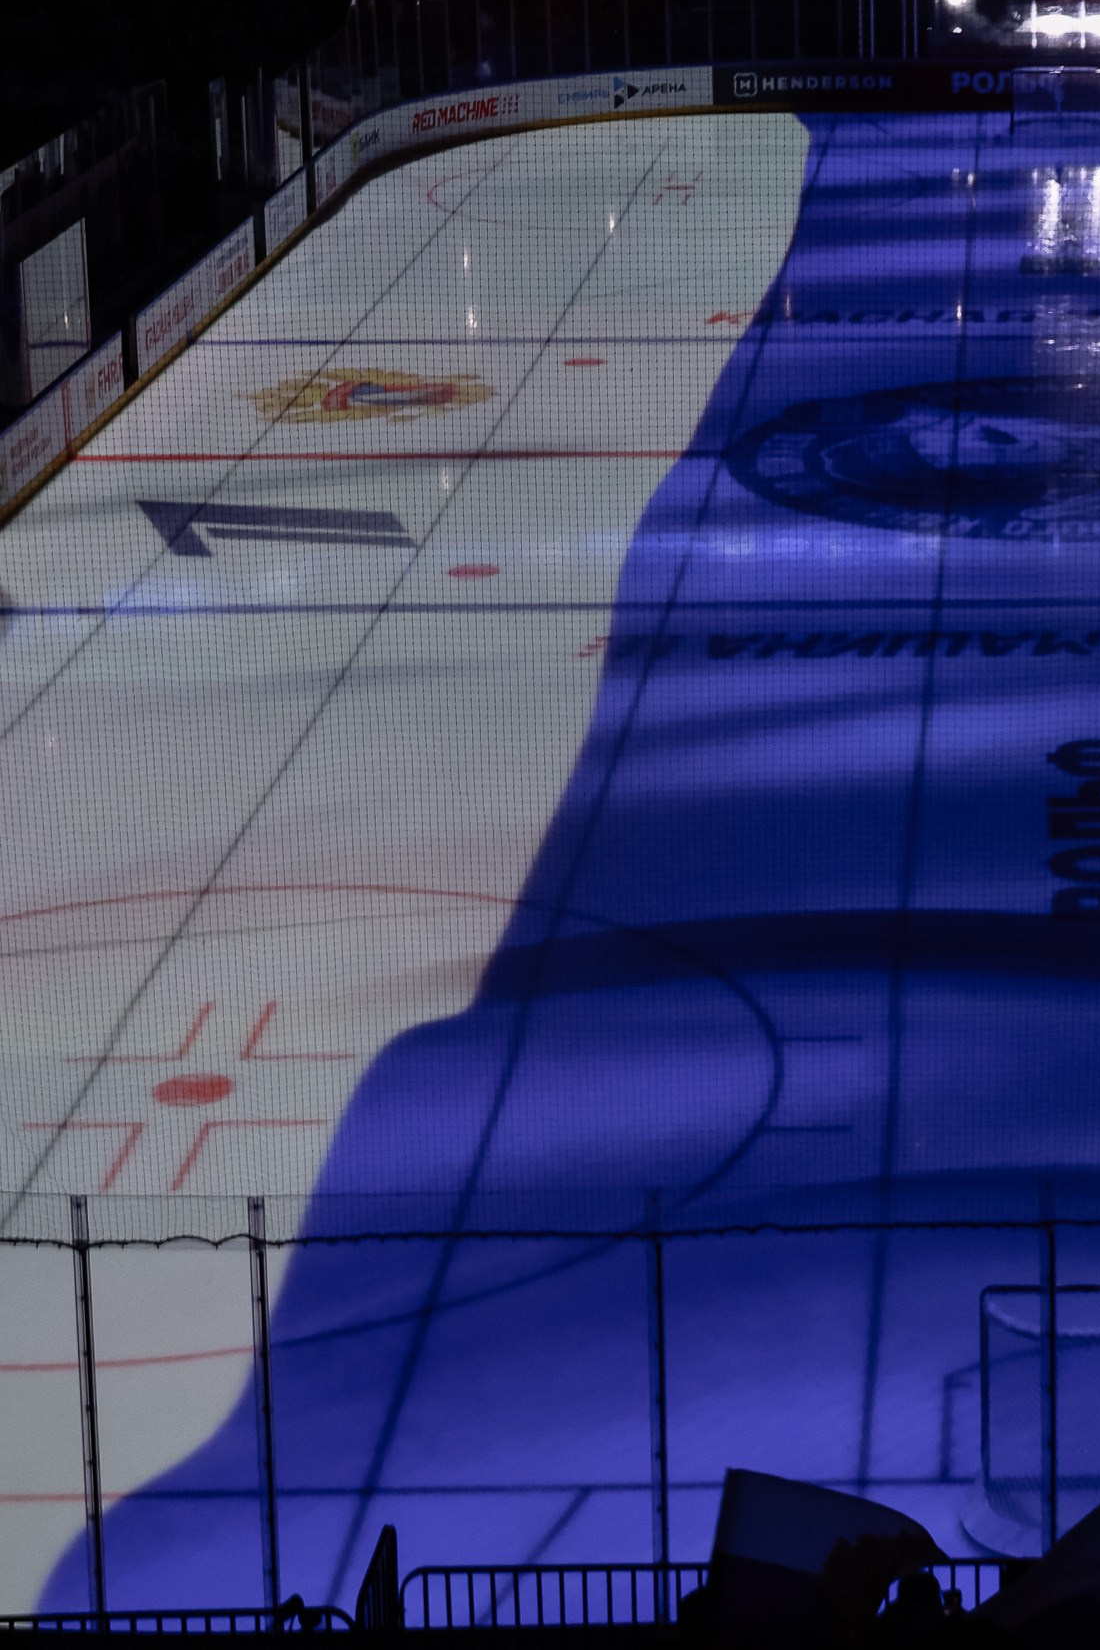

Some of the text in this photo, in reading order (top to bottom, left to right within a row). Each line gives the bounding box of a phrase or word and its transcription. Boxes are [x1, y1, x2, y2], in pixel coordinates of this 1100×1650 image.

[641, 82, 688, 97] АРЕНА
[761, 74, 894, 92] HENDERSON
[412, 97, 499, 133] RED MACHINE
